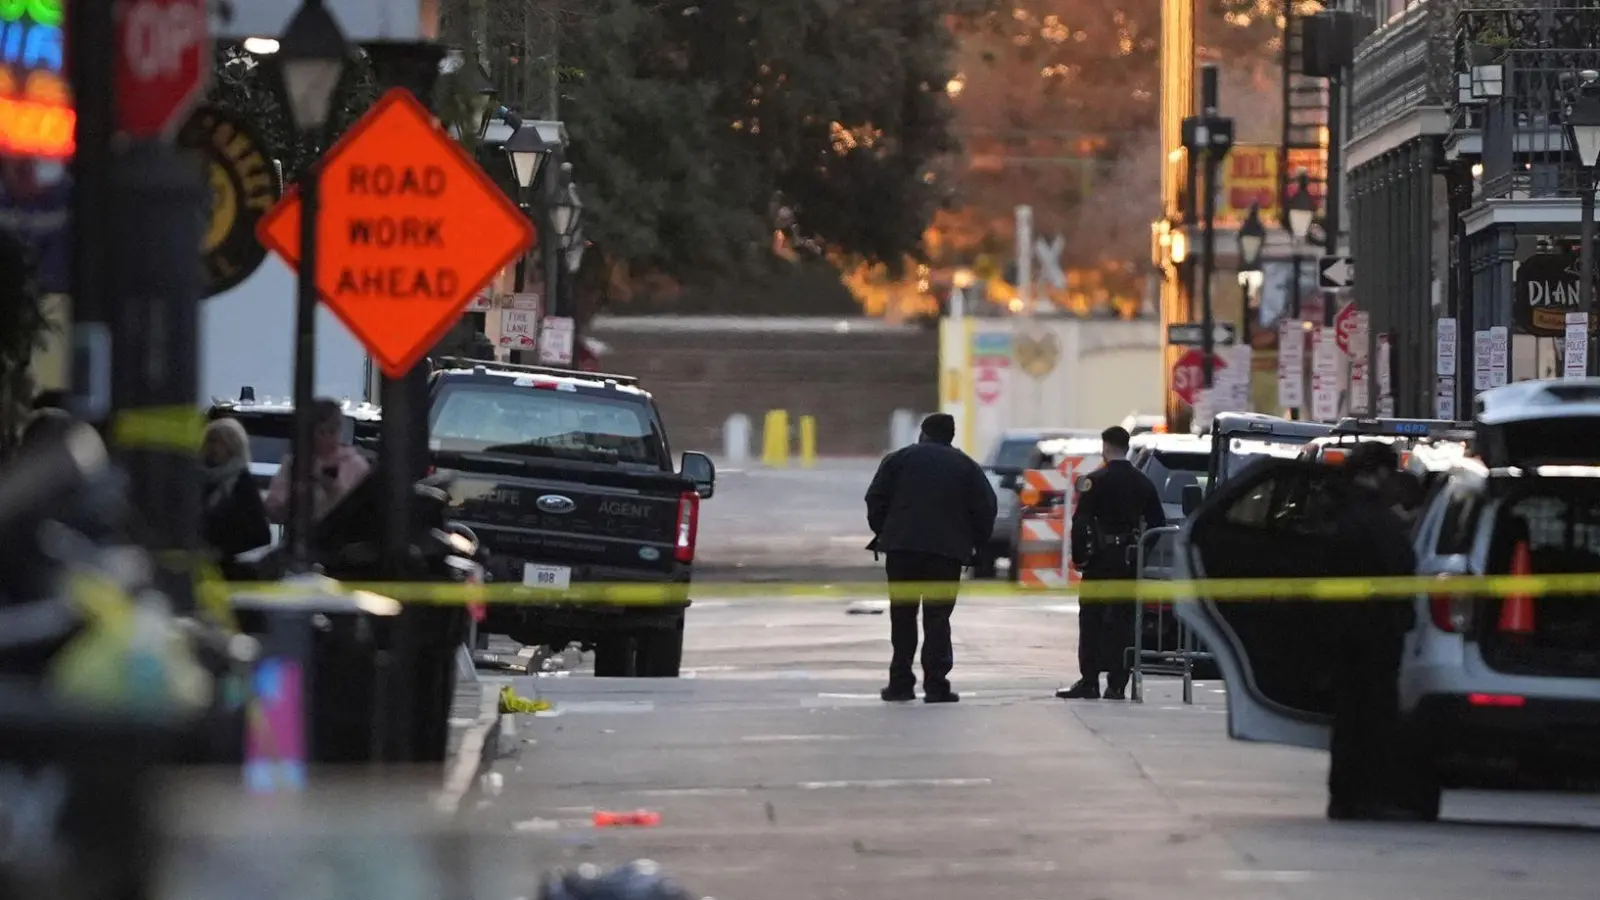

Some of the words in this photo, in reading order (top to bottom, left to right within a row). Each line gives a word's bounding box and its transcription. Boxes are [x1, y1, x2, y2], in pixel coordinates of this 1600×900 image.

[126, 1, 200, 79] OP
[348, 164, 446, 198] ROAD
[347, 217, 444, 249] WORK
[337, 267, 460, 299] AHEAD
[506, 323, 529, 333] LANE
[1567, 340, 1586, 351] POLICE
[1568, 352, 1584, 364] ZONE
[1175, 365, 1201, 389] ST
[598, 501, 653, 518] AGENT
